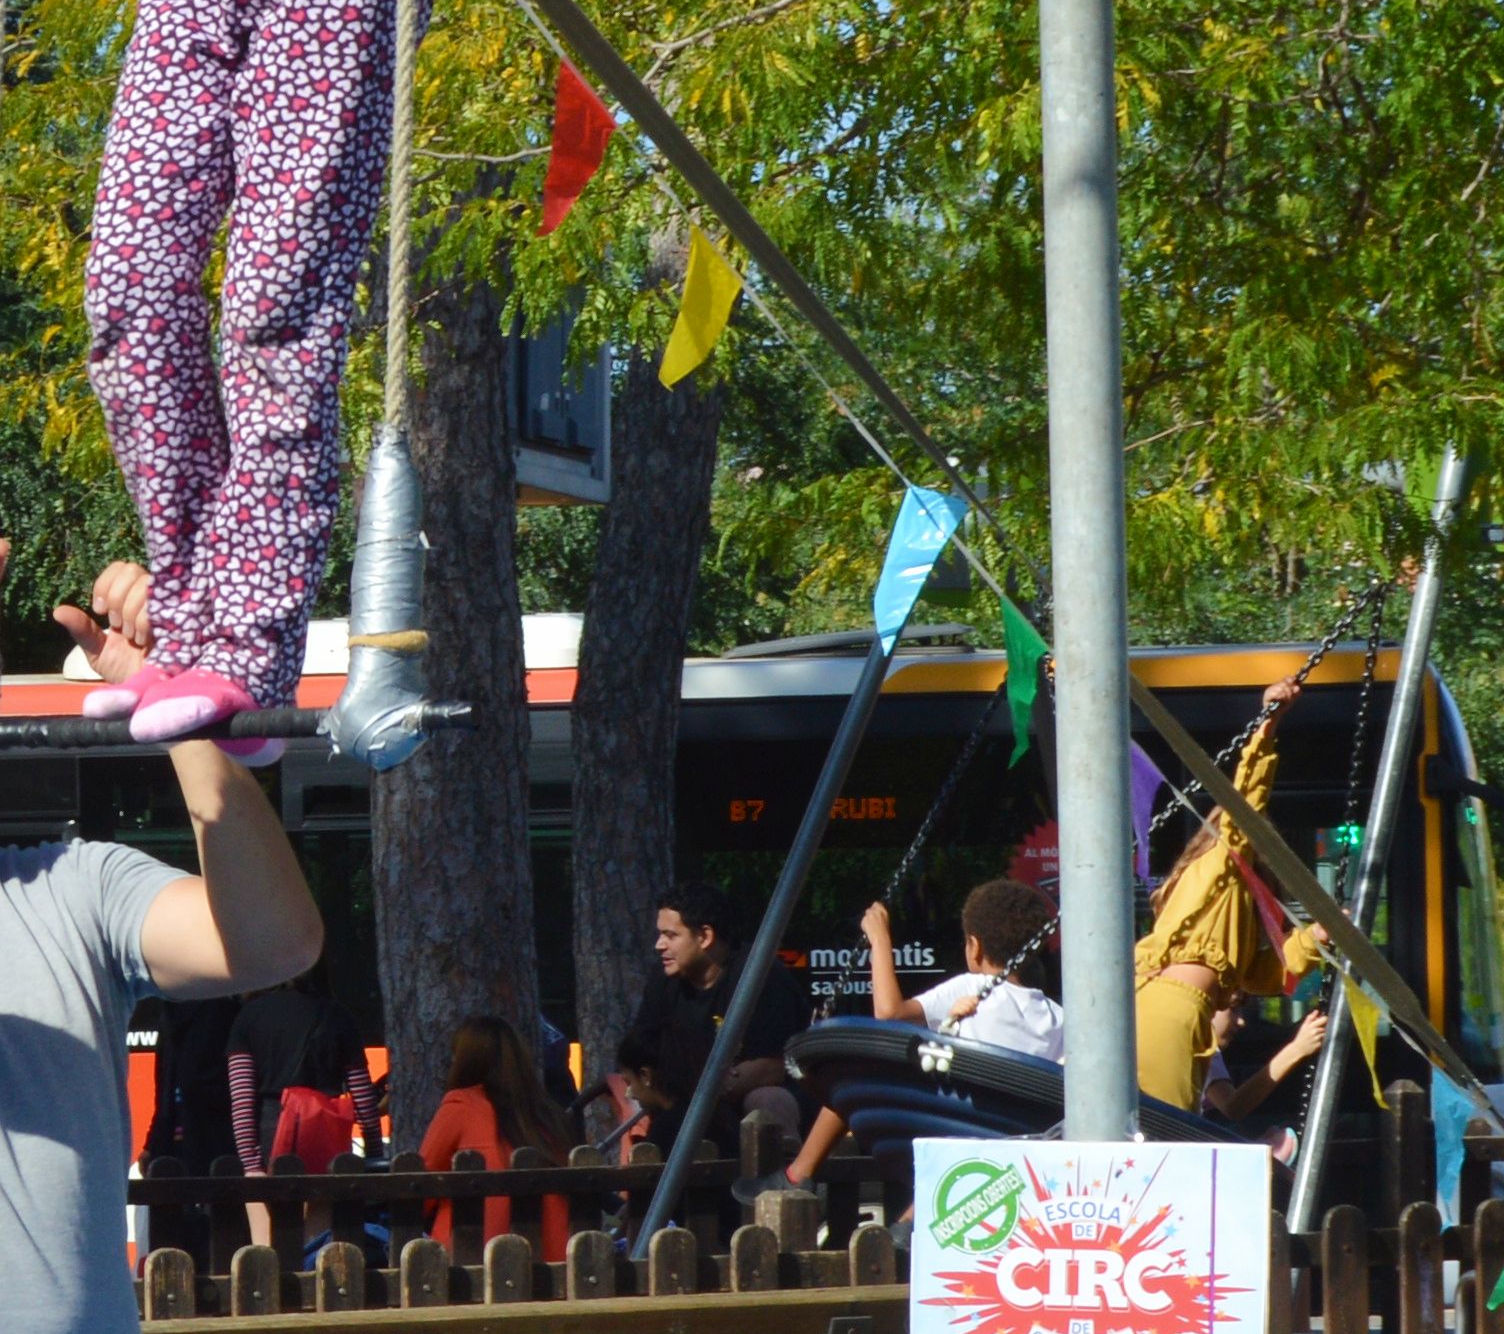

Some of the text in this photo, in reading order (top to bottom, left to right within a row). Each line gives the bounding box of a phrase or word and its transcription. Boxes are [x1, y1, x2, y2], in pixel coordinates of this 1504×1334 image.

[830, 797, 897, 820] RUBI
[810, 941, 936, 968] movntis
[1045, 1201, 1121, 1223] ESCOLA
[1074, 1224, 1093, 1237] DE
[996, 1246, 1174, 1312] CIRC
[1071, 1322, 1091, 1334] DE
